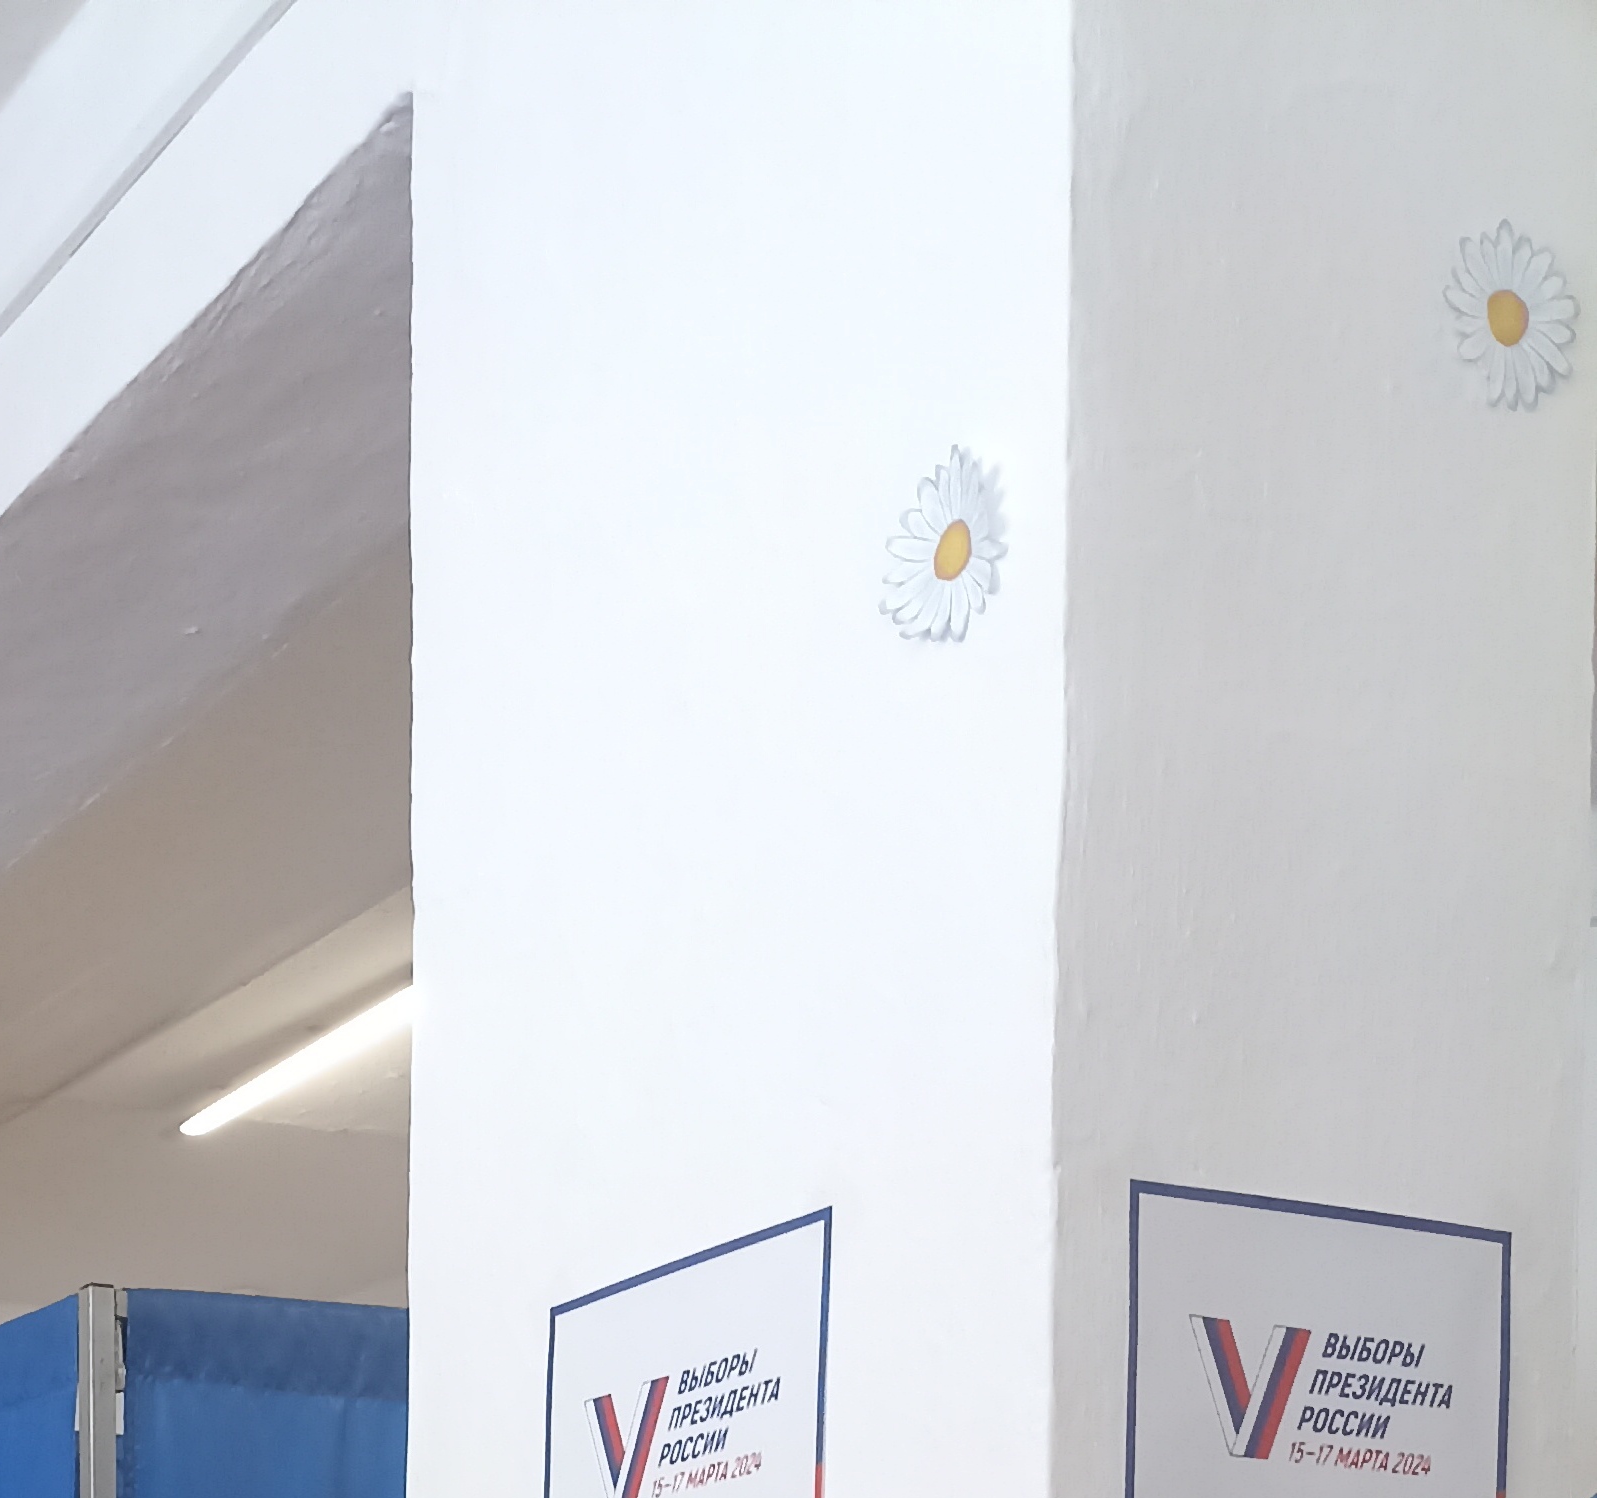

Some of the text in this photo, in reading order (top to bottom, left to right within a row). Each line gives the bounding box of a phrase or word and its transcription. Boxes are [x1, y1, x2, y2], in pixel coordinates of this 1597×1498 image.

[1322, 1332, 1425, 1369] ВЫБОРЫ
[677, 1348, 758, 1395] ВЫБОРЫ
[1309, 1368, 1453, 1410] ПРЕЗИДЕНТА
[668, 1376, 781, 1431] ПРЕЗИДЕНТА
[1297, 1406, 1391, 1440] РОССИИ
[658, 1427, 729, 1468] РОССИИ
[1334, 1446, 1390, 1471] МАРТА
[1392, 1451, 1431, 1476] 2024
[686, 1461, 729, 1489] МАРТА
[730, 1451, 762, 1478] 2024
